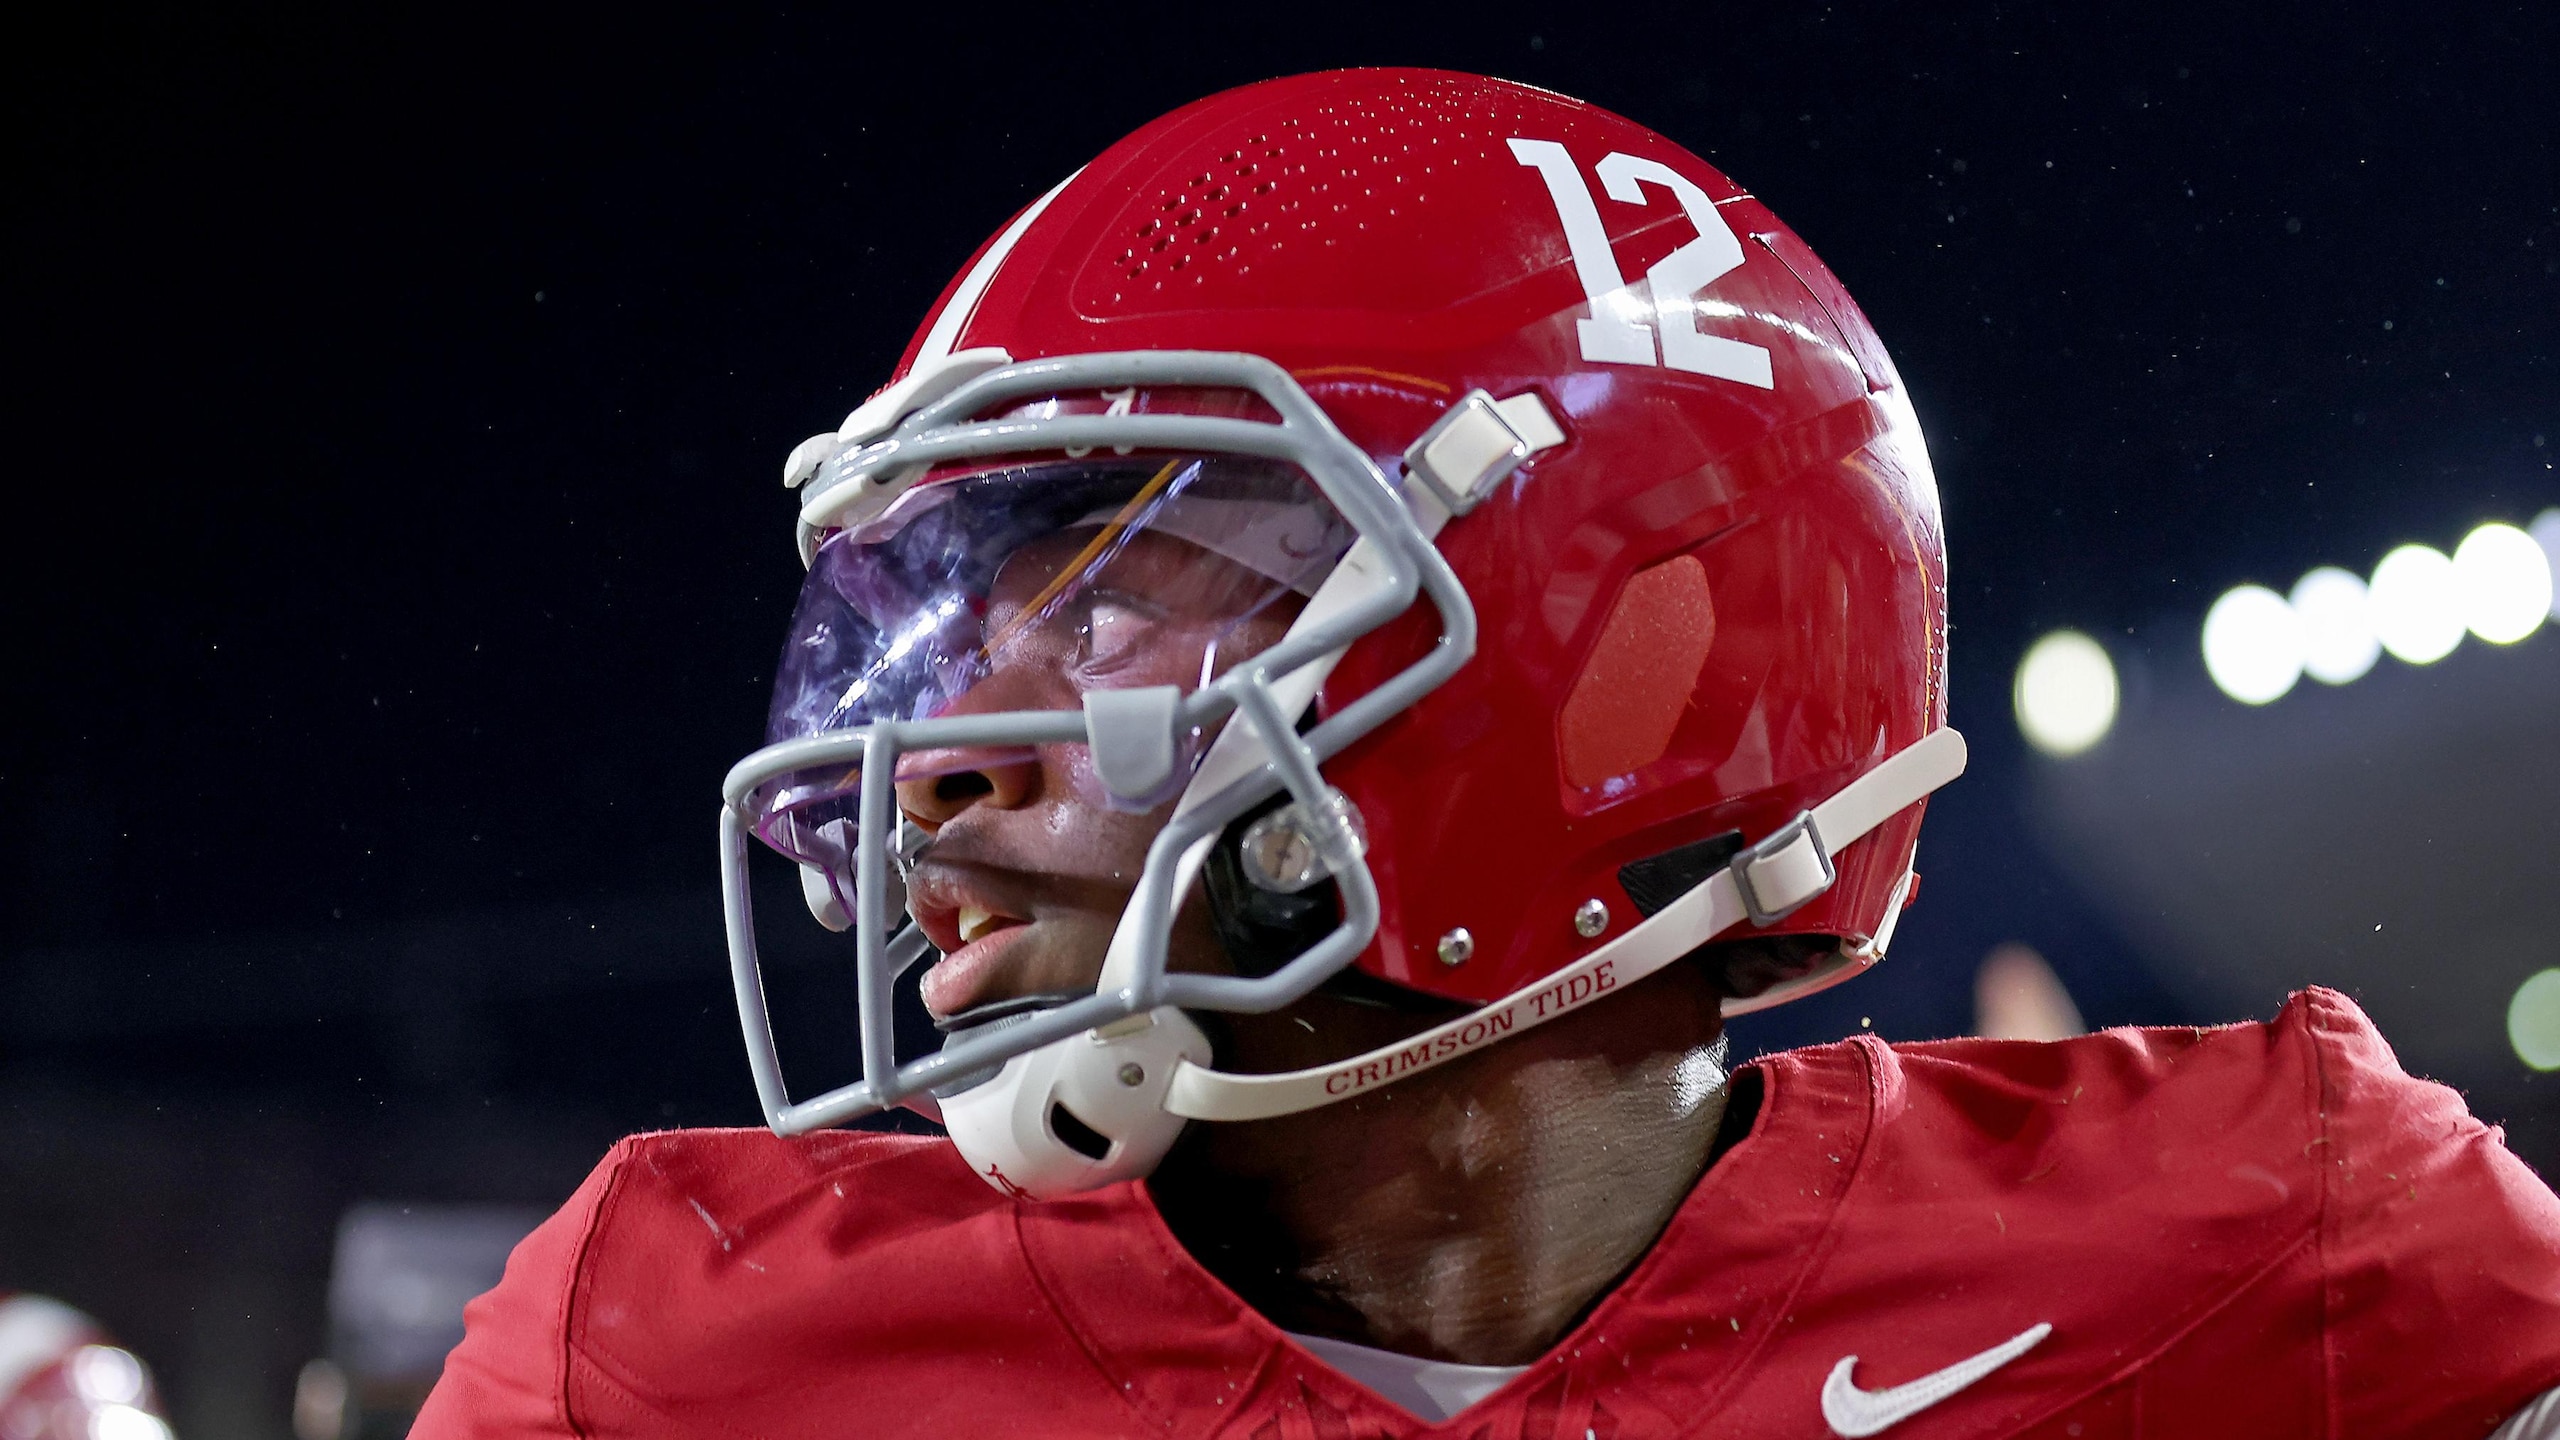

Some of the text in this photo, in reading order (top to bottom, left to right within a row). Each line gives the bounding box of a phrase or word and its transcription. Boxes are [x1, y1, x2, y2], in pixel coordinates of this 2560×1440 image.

[1506, 138, 1774, 390] 12
[1325, 960, 1617, 1096] CRIMSON TIDE
